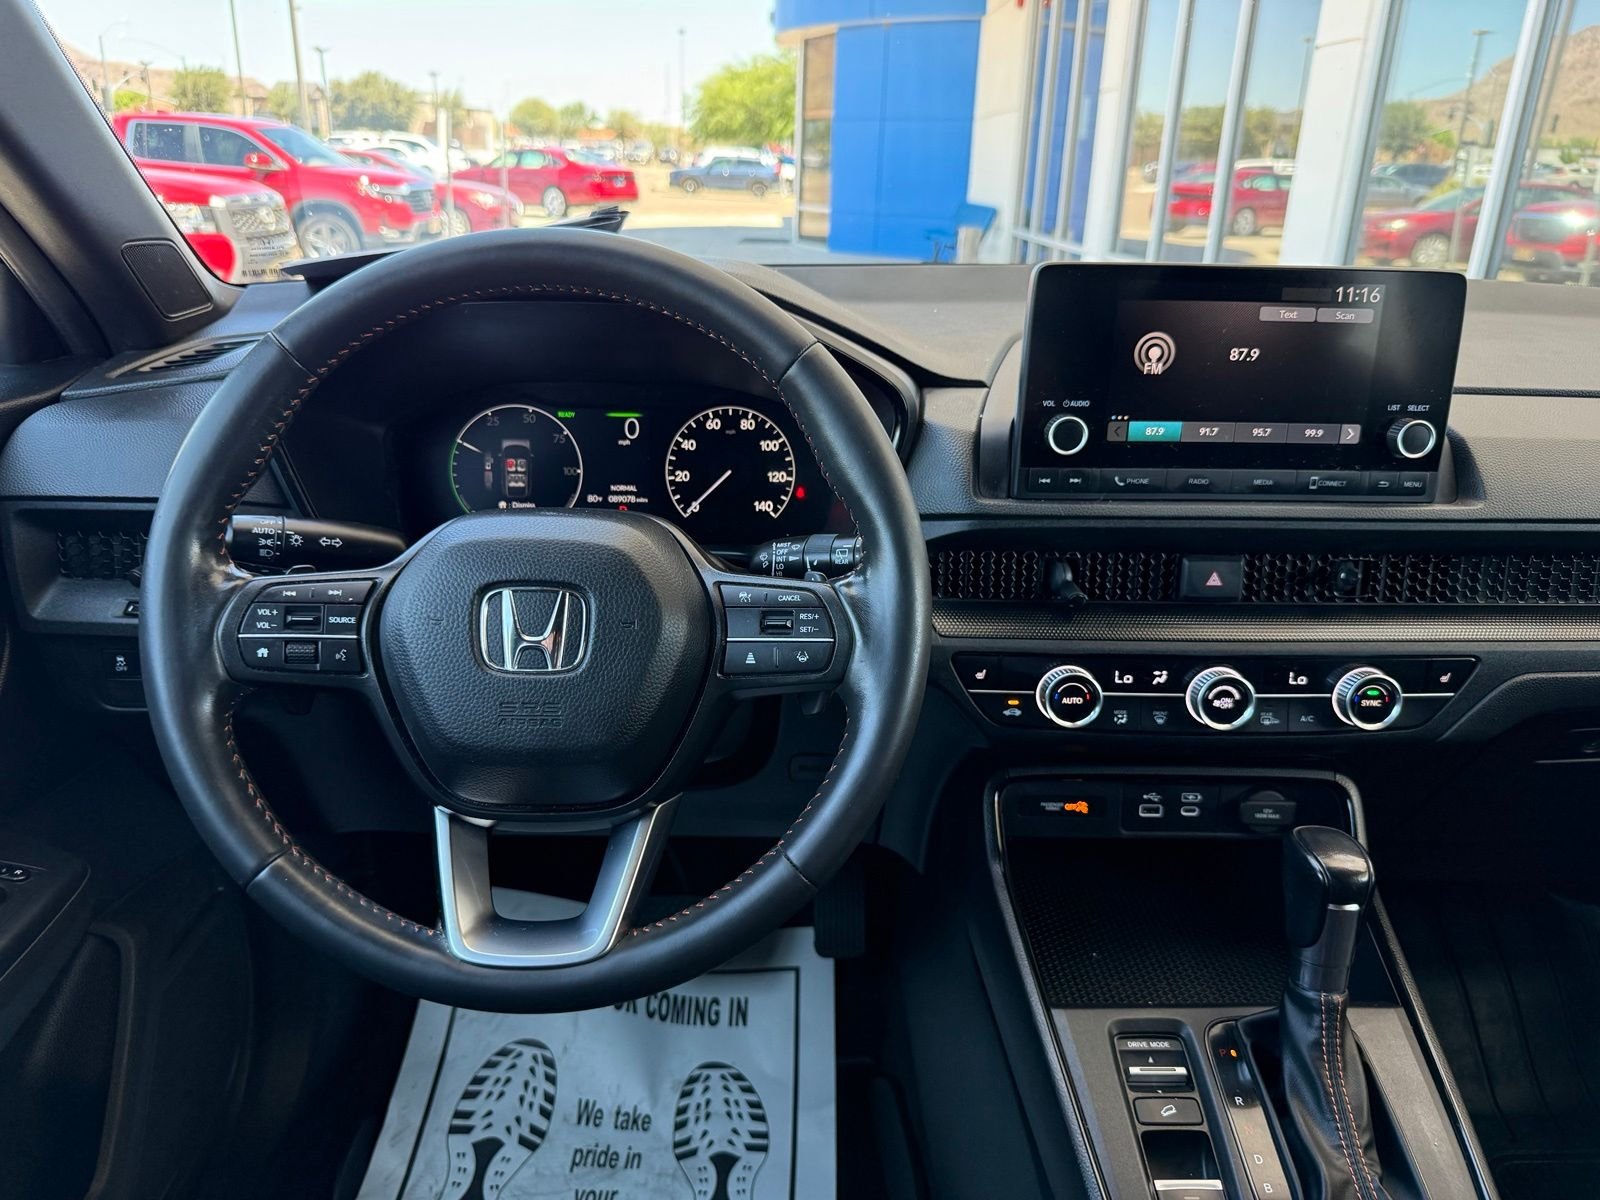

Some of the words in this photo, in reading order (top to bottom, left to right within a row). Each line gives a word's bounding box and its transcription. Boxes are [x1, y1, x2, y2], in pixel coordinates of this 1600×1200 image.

[1335, 286, 1381, 303] 11:16
[1279, 310, 1299, 319] Text
[1335, 311, 1355, 320] Scan
[1229, 348, 1260, 361] 87.9
[1143, 362, 1162, 375] FM
[1387, 404, 1400, 412] LIST
[487, 416, 500, 426] 25
[523, 413, 536, 424] 50
[624, 418, 640, 440] 0
[705, 419, 721, 430] 60
[740, 419, 756, 430] 80
[1145, 427, 1165, 436] 87.9
[1199, 427, 1219, 436] 91.7
[1252, 428, 1272, 437] 95.7
[1304, 429, 1325, 438] 99.9
[553, 434, 566, 444] 75
[680, 439, 697, 451] 40
[759, 440, 780, 451] 100
[674, 470, 690, 482] 20
[767, 471, 787, 482] 120
[607, 495, 636, 503] 089078
[753, 500, 774, 512] 140
[328, 616, 357, 624] SOURCE
[1061, 696, 1084, 704] AUTO
[1300, 714, 1314, 722] A/C
[646, 991, 721, 1027] COMING
[728, 996, 749, 1027] IN
[1219, 1048, 1227, 1057] P
[1234, 1096, 1244, 1106] R
[576, 1098, 604, 1128] We
[614, 1104, 652, 1132] take
[569, 1142, 620, 1173] pride
[624, 1145, 643, 1169] in
[1254, 1154, 1263, 1164] D
[1263, 1183, 1272, 1193] B
